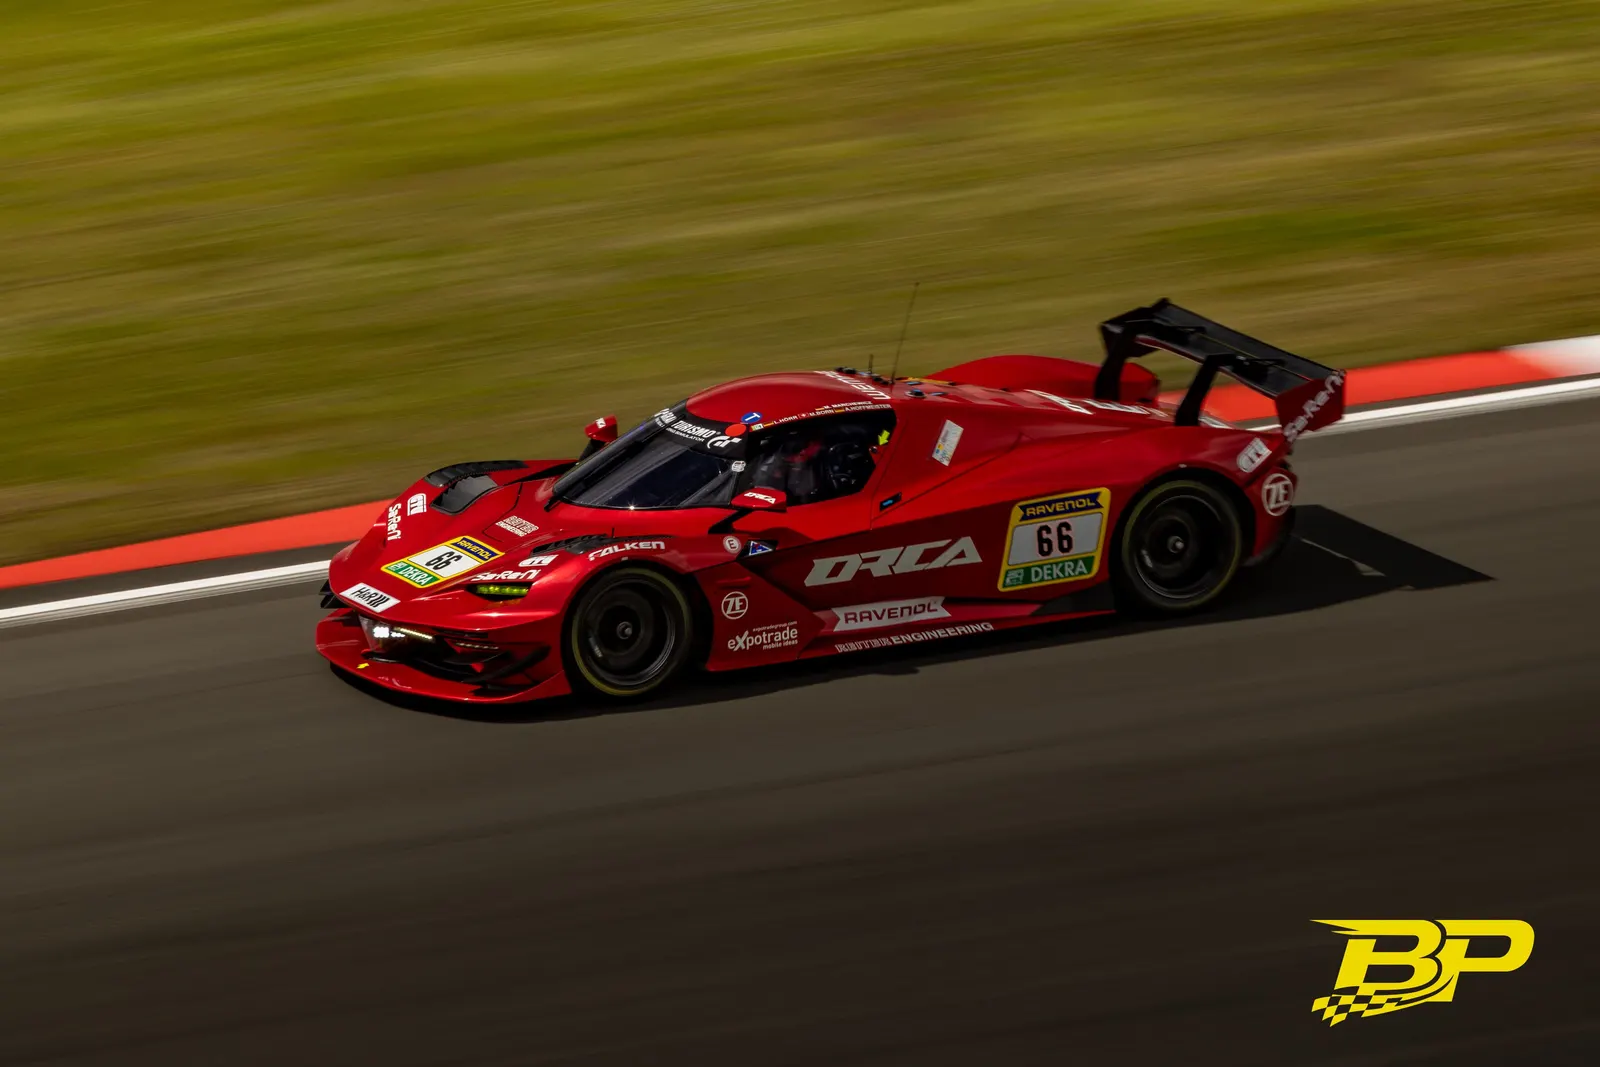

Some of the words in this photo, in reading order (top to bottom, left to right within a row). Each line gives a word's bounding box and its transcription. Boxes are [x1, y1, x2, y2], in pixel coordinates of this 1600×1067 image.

[1026, 497, 1096, 517] RAVENOL
[456, 539, 492, 560] RAVENOL
[1037, 521, 1074, 557] 66
[425, 551, 462, 570] 66
[588, 541, 666, 561] FALKEN
[804, 536, 983, 587] ORCA
[398, 566, 433, 585] DEKRA
[1031, 560, 1088, 582] DEKRA
[723, 594, 747, 616] ZF
[844, 602, 938, 624] RAVENOL
[783, 639, 798, 647] ideas
[890, 622, 995, 644] ENGINEERING
